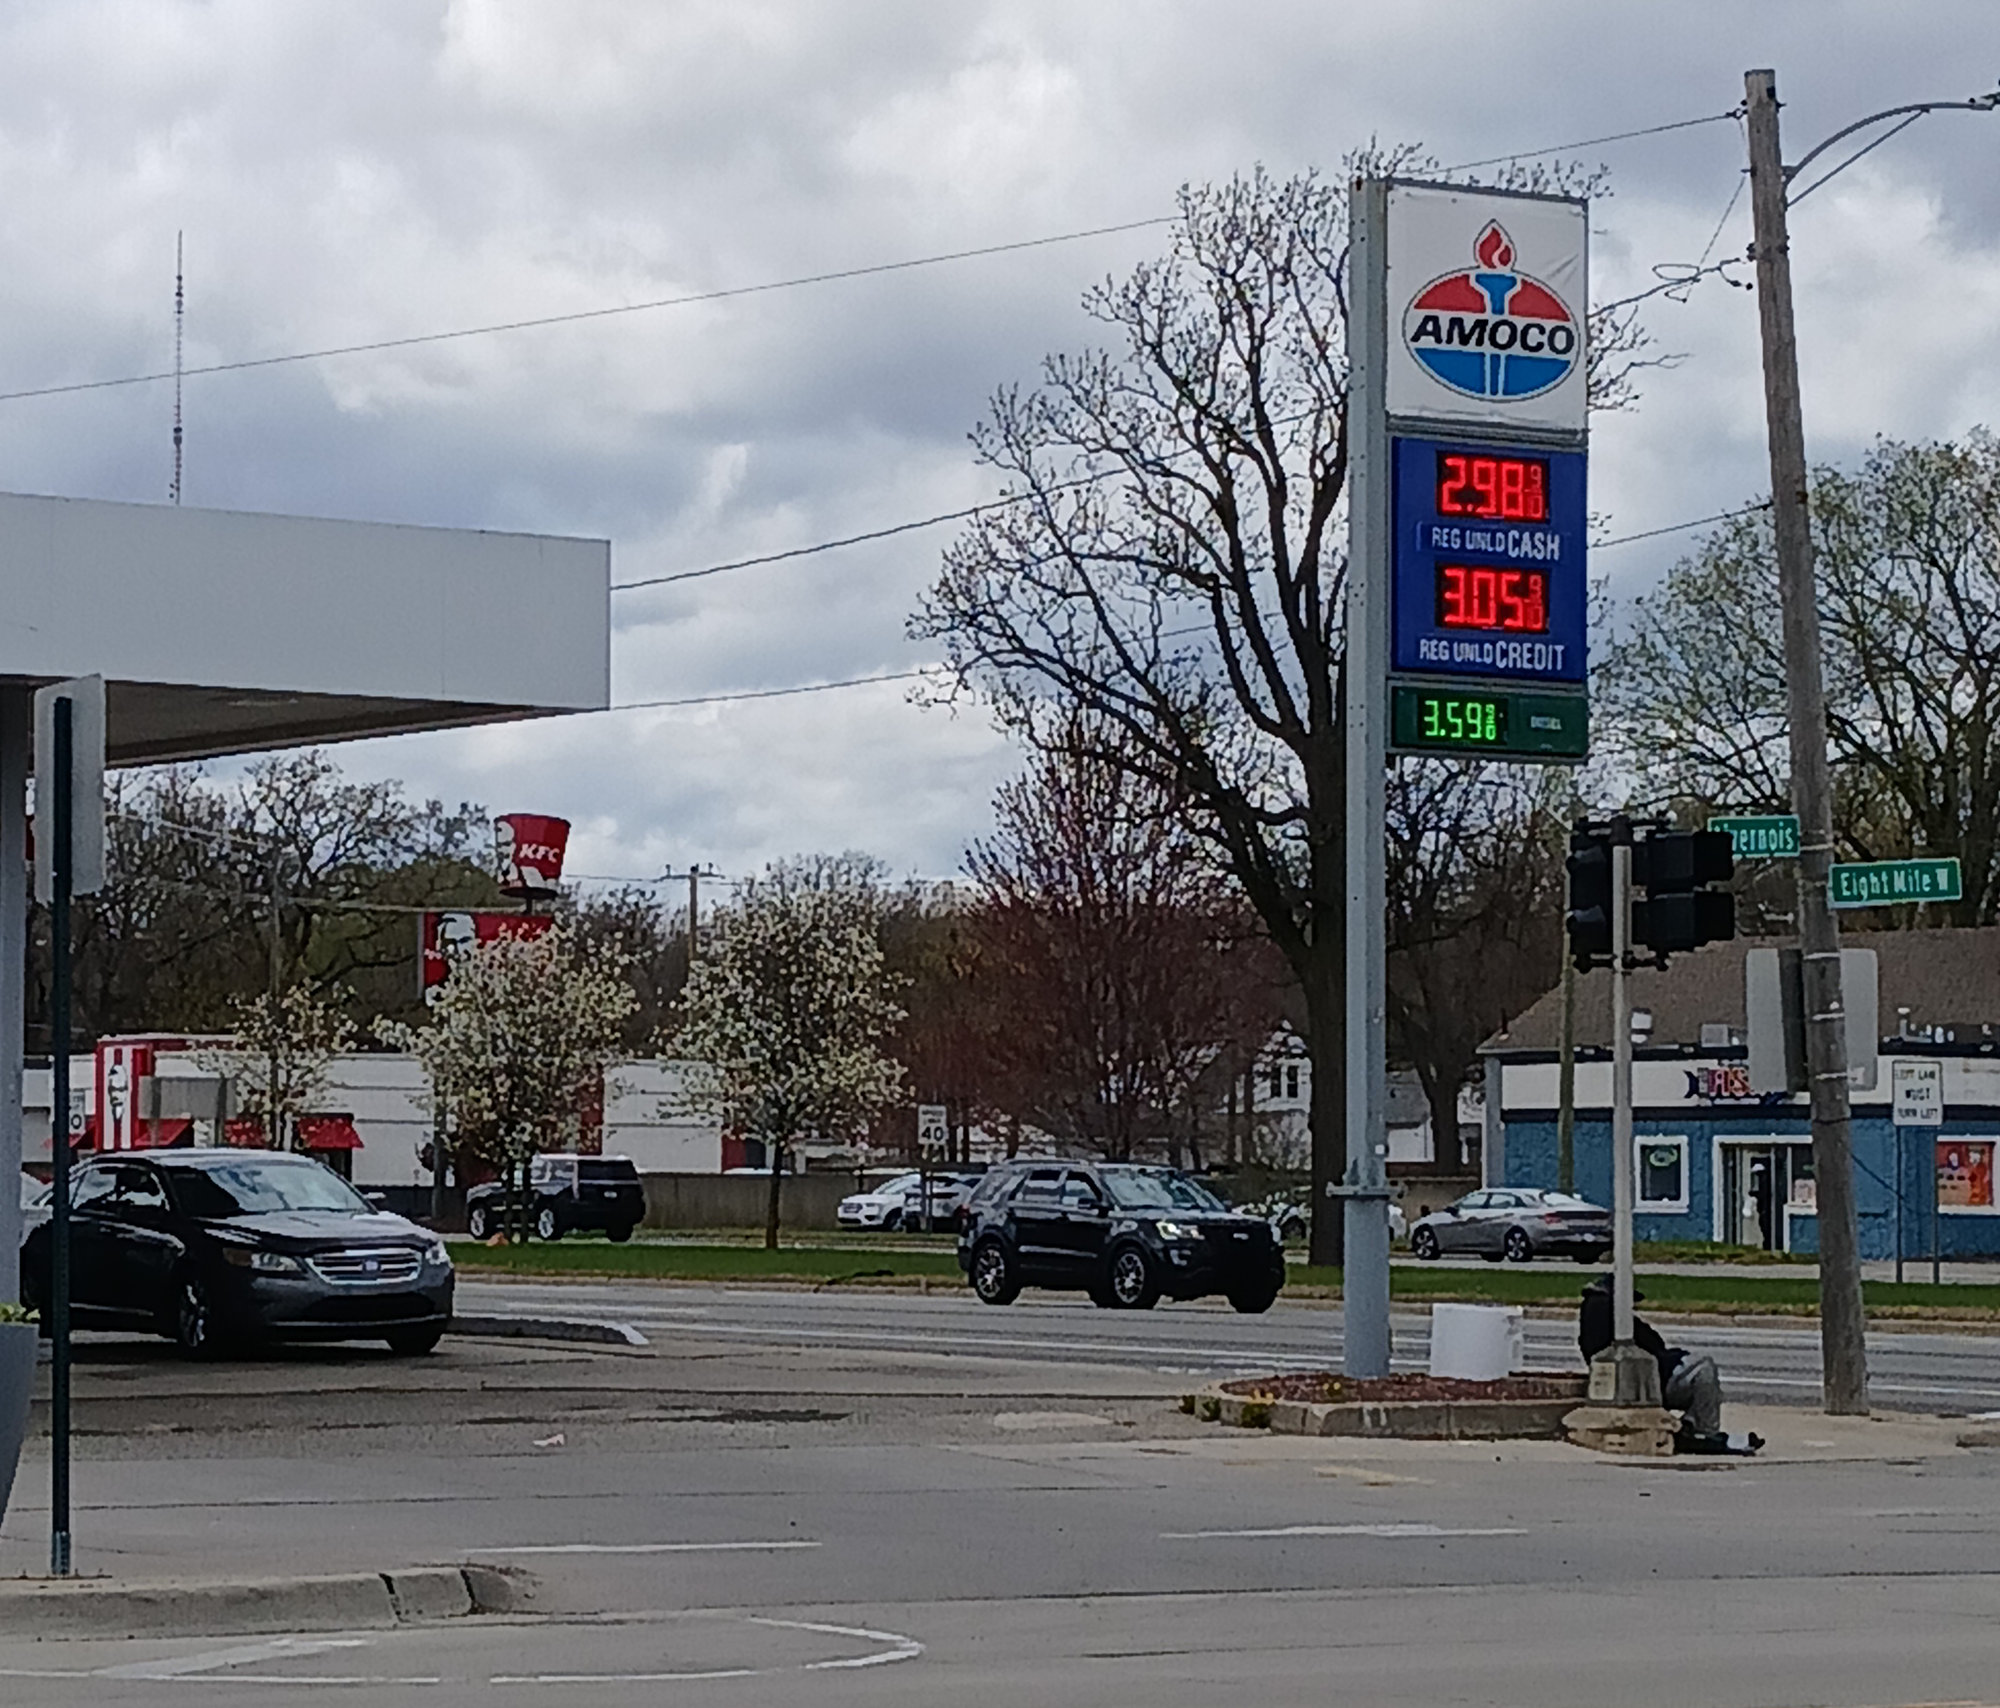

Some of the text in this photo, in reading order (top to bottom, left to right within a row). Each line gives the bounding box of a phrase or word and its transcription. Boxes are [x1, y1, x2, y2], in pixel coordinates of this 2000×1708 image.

[1410, 315, 1575, 355] AMOCO
[1432, 527, 1461, 549] REG
[1507, 530, 1560, 561] CASH
[1420, 639, 1449, 661] REG
[1495, 641, 1565, 671] CREDIT
[1424, 700, 1482, 739] 3.59
[1714, 821, 1794, 851] vernois
[519, 843, 561, 863] KFC
[1840, 872, 1889, 901] Eight
[1894, 869, 1931, 893] Mile
[921, 1126, 944, 1142] 40
